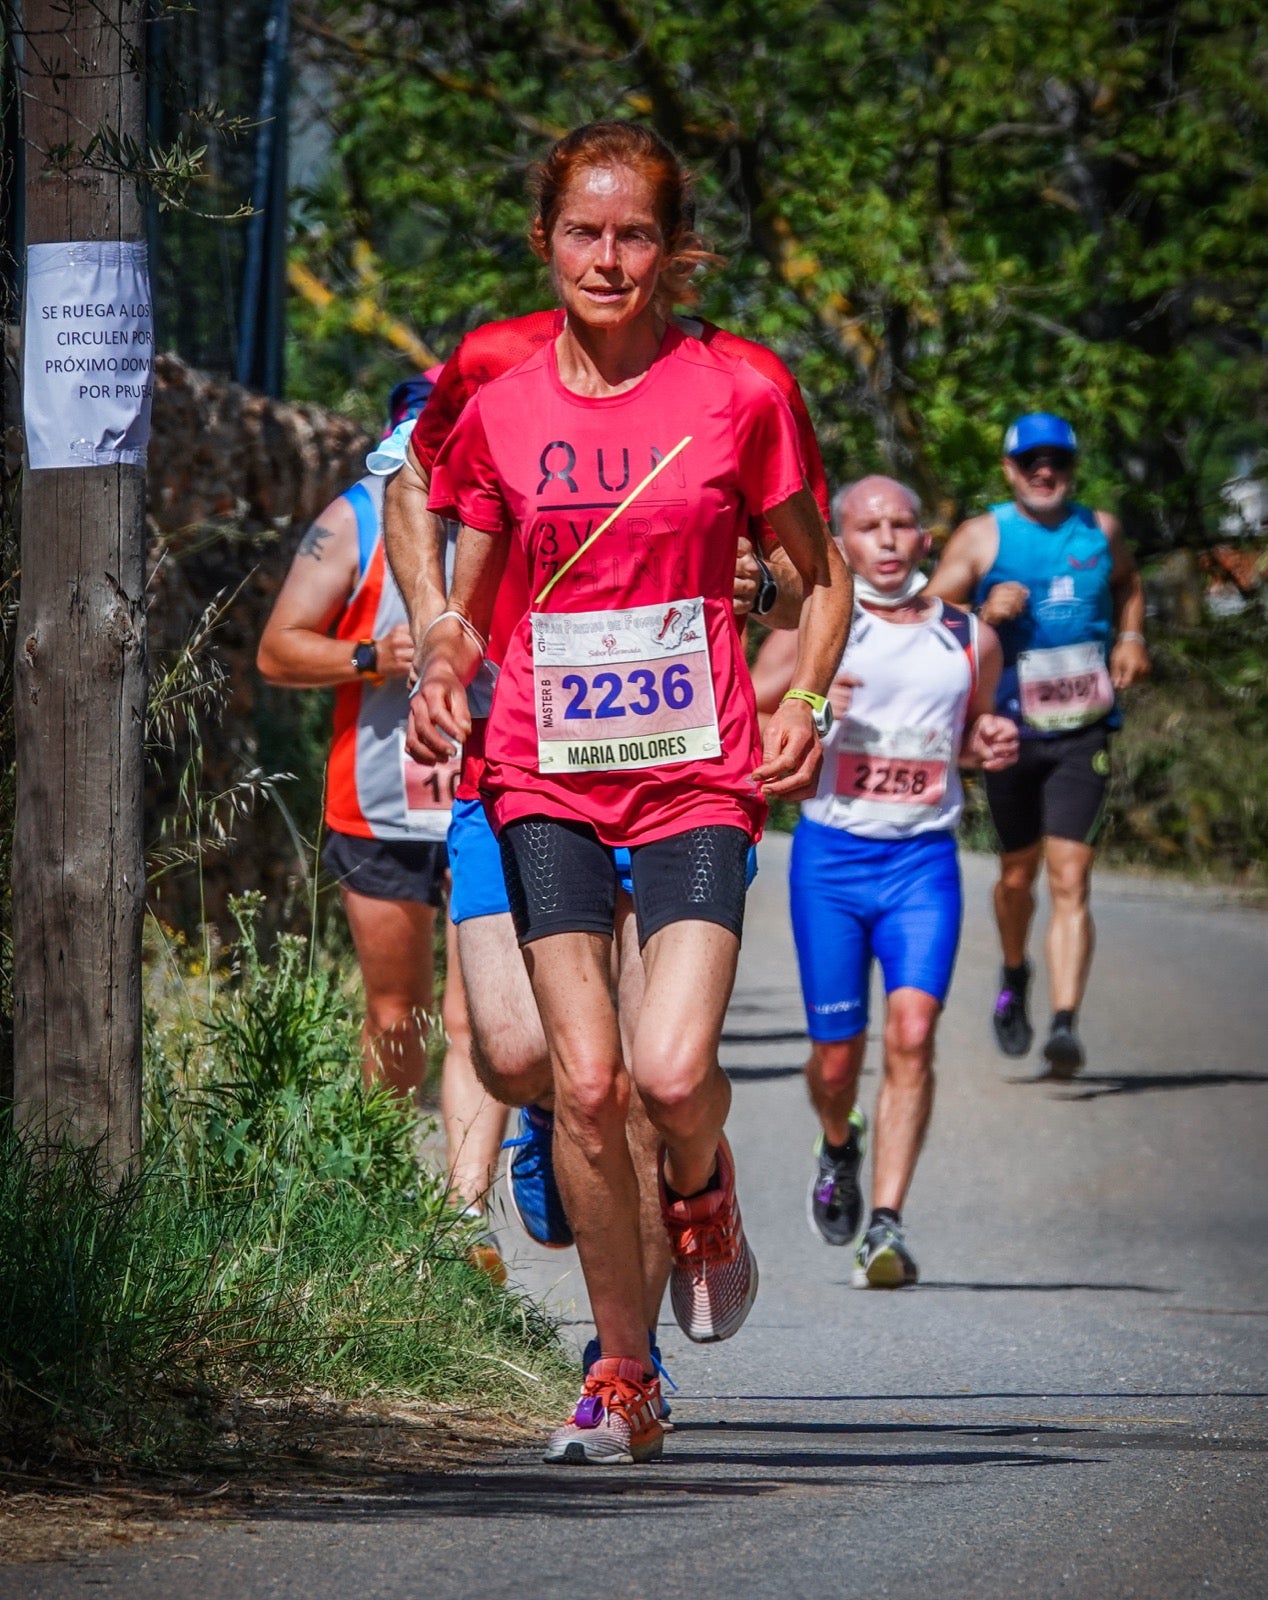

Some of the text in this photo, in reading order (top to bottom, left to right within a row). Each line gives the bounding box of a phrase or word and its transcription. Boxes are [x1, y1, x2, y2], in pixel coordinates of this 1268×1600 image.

[42, 303, 150, 319] SE RUEGA A LOS
[57, 331, 152, 346] CIRCULEN POR
[45, 356, 118, 374] PRÓXIMO
[79, 385, 110, 399] POR
[536, 440, 687, 495] RUN
[561, 663, 694, 720] 2236
[542, 688, 554, 728] MASTER
[567, 736, 687, 766] MARIA DOLORES
[854, 764, 927, 795] 2258
